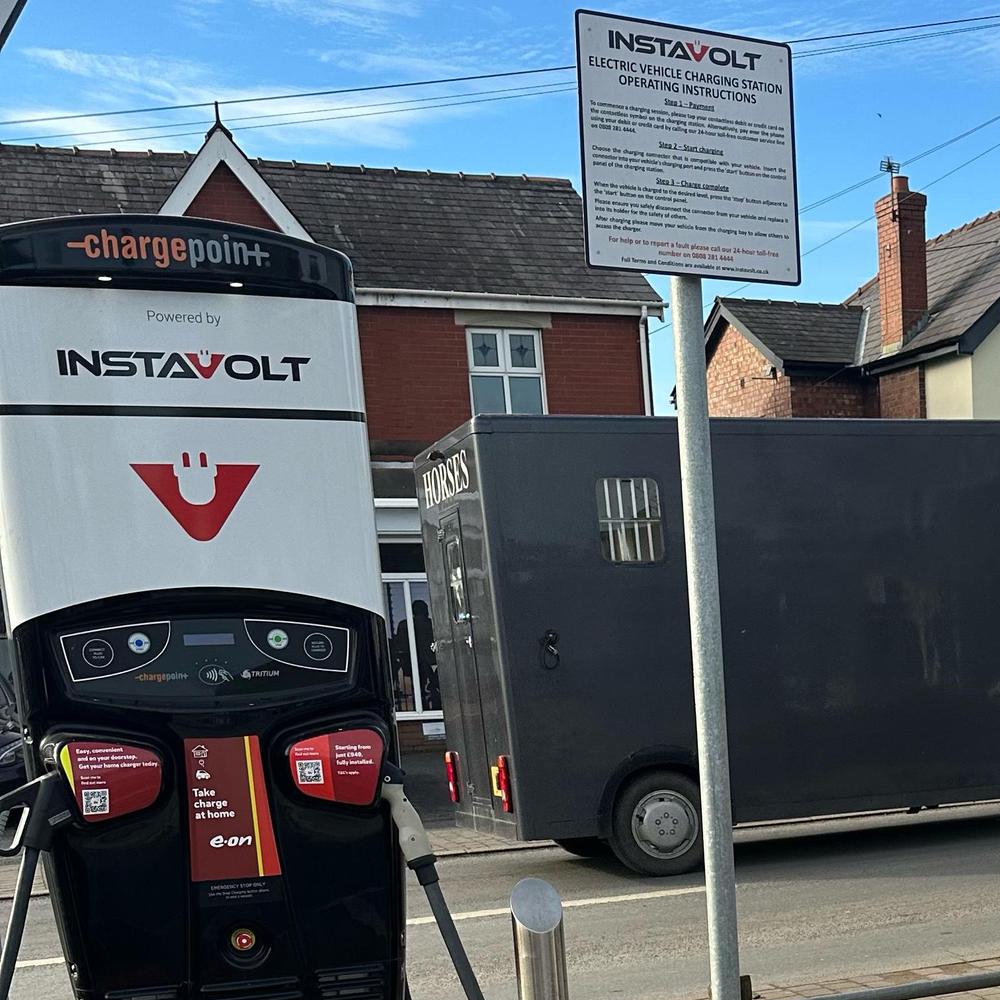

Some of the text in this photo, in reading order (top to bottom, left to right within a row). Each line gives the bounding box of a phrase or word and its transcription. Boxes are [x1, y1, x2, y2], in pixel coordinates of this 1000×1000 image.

[608, 29, 762, 71] INSTAVOLT
[588, 55, 782, 94] ELECTRIC VEHICLE CHARGING STATION
[618, 74, 756, 104] OPERATING INSTRUCTIONS
[146, 309, 221, 327] Powered by
[56, 349, 311, 382] INSTAVOLT
[422, 449, 470, 509] HORSES
[335, 744, 357, 752] Starting
[192, 788, 216, 797] Take
[194, 799, 228, 810] charge
[195, 809, 236, 820] at home
